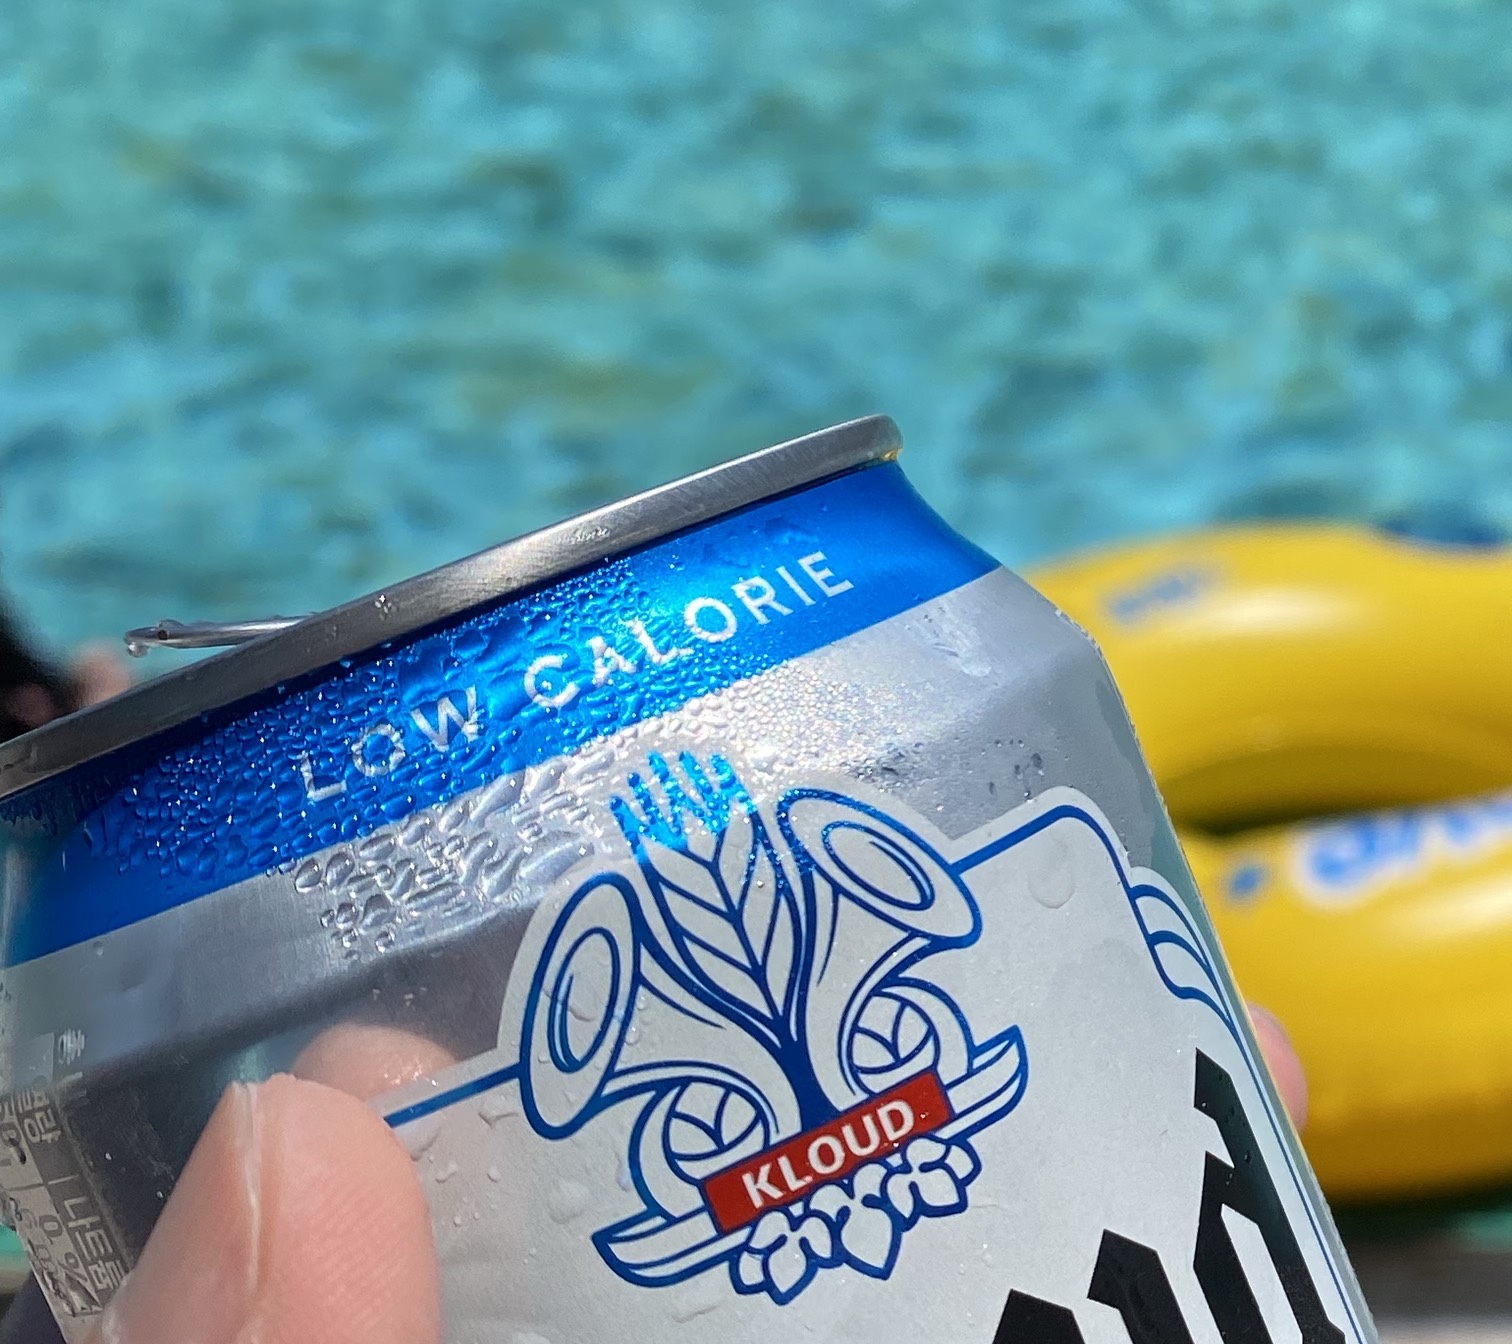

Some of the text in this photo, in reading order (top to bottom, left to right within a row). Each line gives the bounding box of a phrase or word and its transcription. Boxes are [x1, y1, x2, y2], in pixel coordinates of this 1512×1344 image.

[296, 550, 854, 802] LOW CALORIE
[742, 1098, 917, 1210] KLOUD
